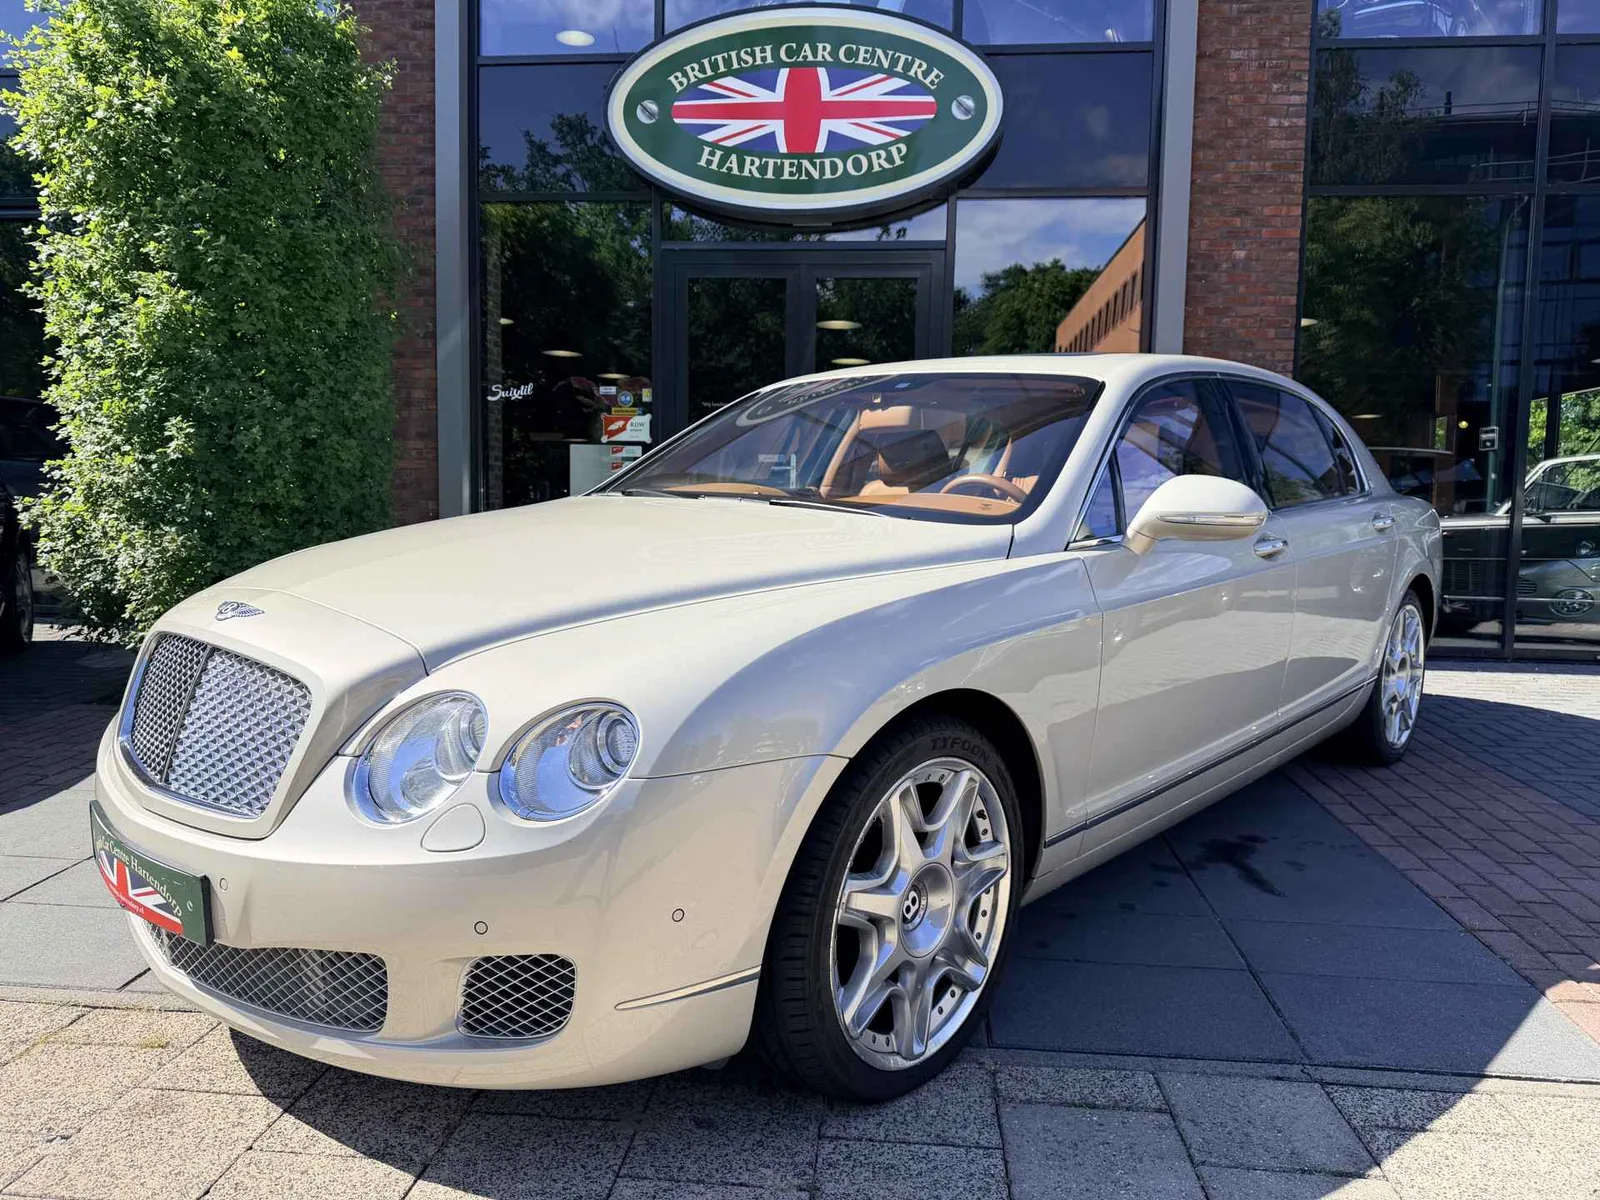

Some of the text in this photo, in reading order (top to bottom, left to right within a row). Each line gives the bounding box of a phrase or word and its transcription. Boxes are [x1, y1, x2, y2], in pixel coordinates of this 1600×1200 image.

[667, 42, 945, 93] BRITISH CAR CENTRE
[697, 143, 908, 180] HARTENDORP
[130, 855, 182, 916] Hartendorp
